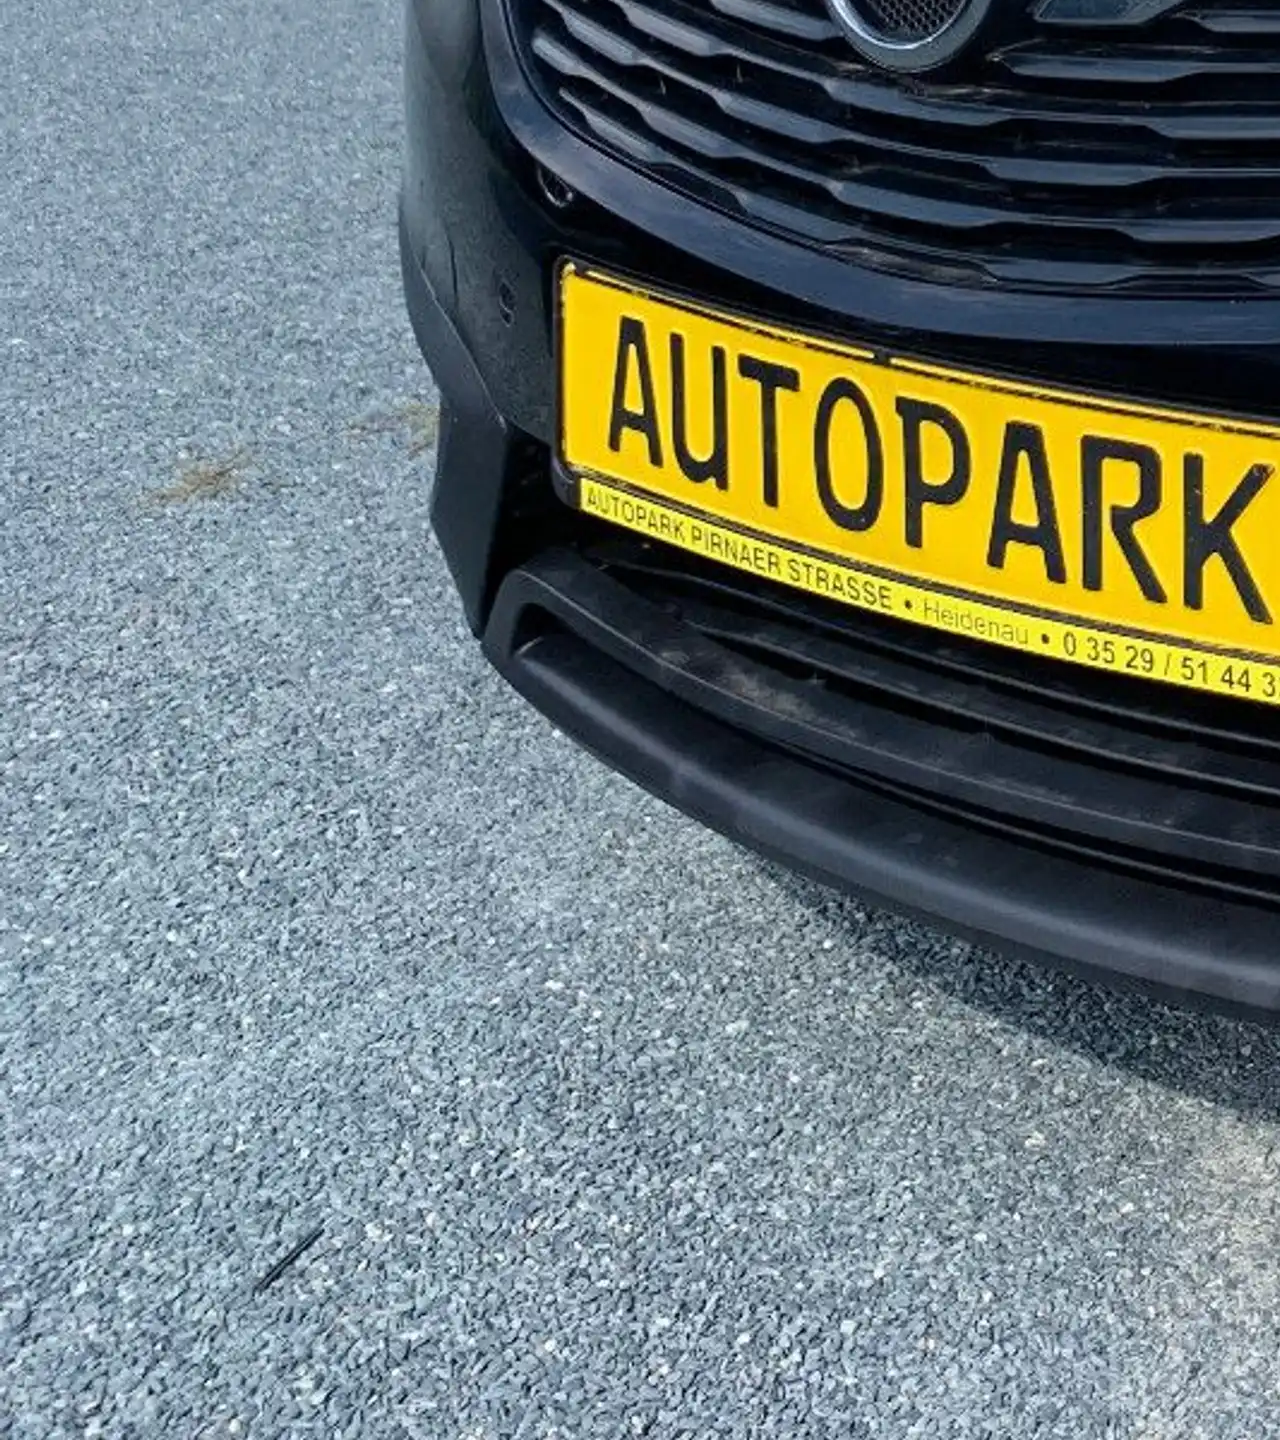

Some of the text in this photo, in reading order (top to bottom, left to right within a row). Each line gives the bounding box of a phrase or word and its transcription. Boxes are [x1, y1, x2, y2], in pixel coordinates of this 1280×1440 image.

[586, 486, 686, 542] AUTOPARK
[691, 528, 781, 576] PIRNAER
[787, 558, 893, 610] STRASSE
[922, 600, 1029, 646] Heidenau
[1063, 632, 1077, 656] 0
[1086, 638, 1115, 663] 35
[1125, 646, 1154, 672] 29
[1180, 659, 1209, 685] 51
[1220, 666, 1252, 692] 44
[607, 315, 1276, 626] AUTOPARK
